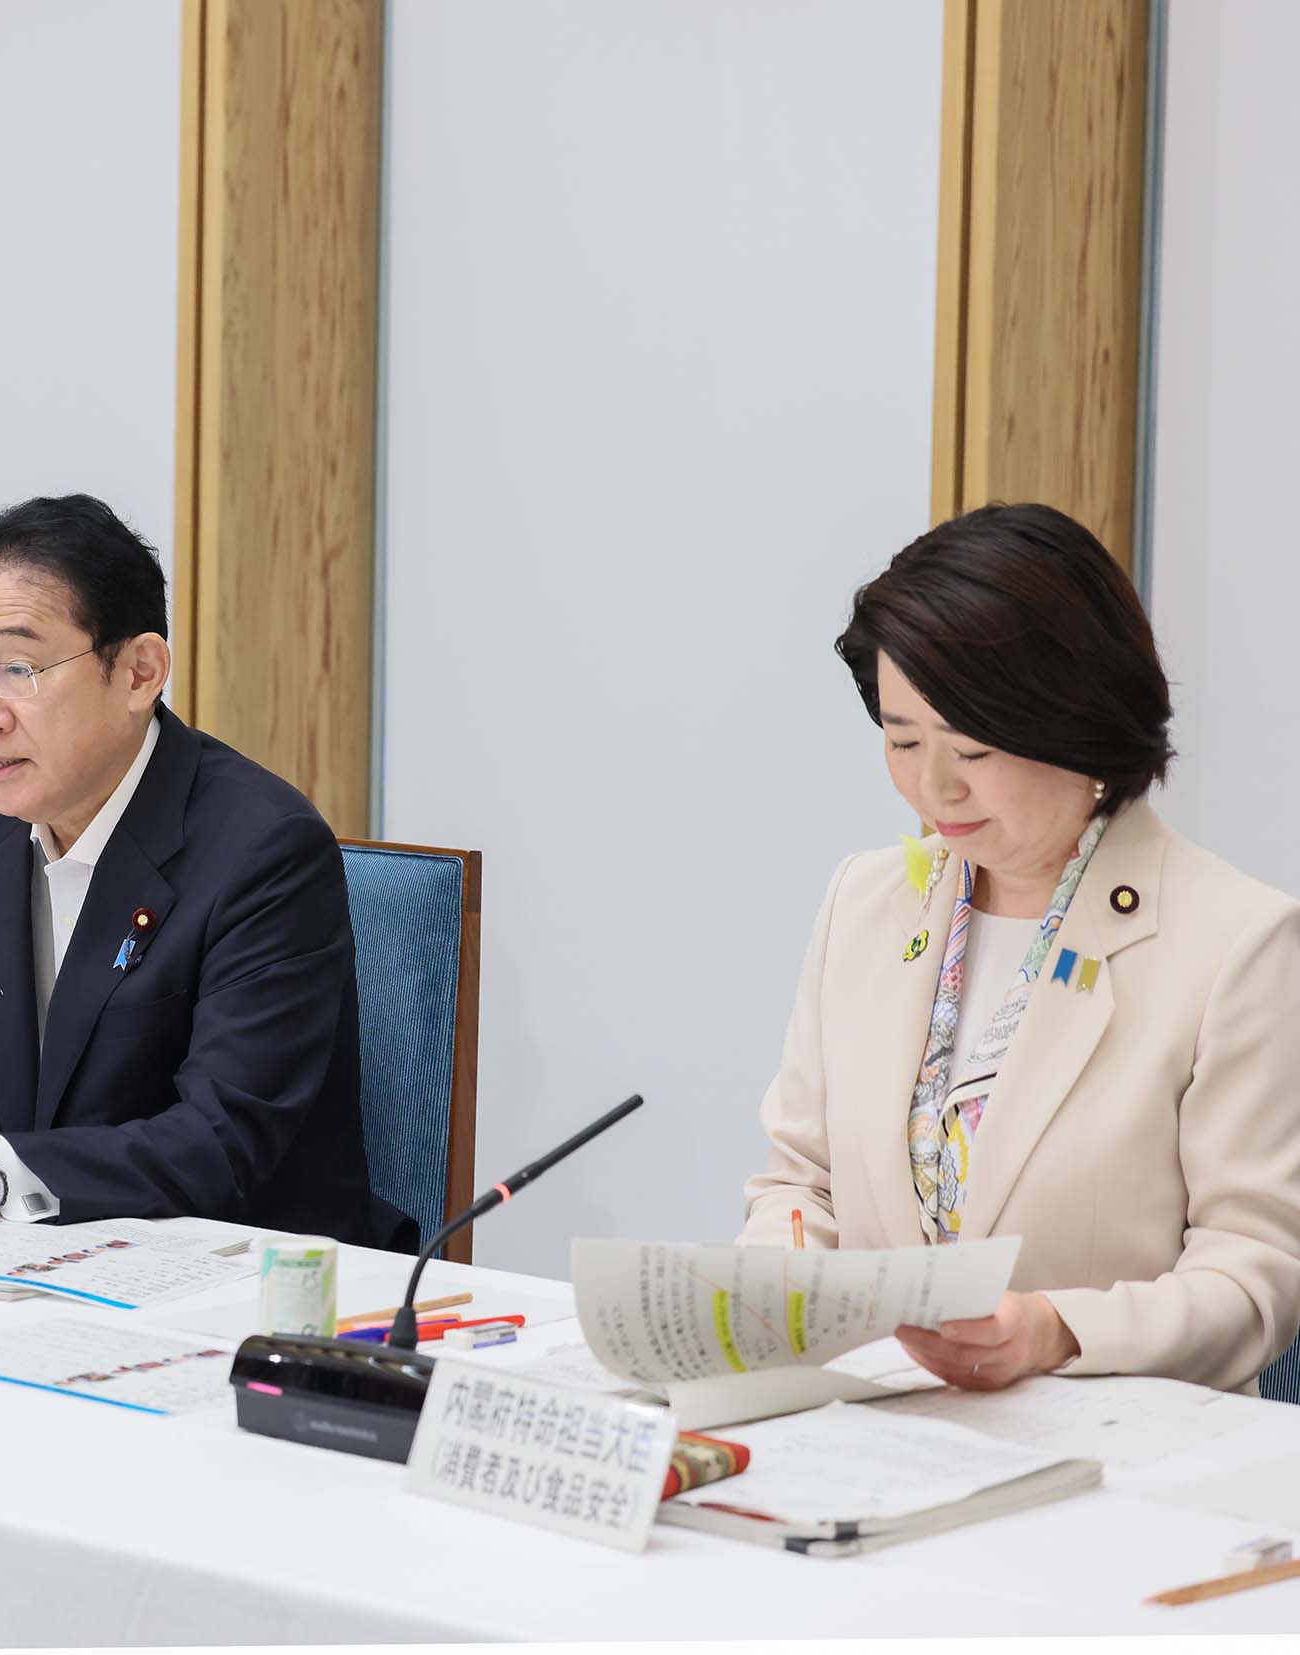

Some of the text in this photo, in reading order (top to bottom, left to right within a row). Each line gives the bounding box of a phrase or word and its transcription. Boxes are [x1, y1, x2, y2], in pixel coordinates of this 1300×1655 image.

[441, 1376, 658, 1474] 内閣府特命担当大臣
